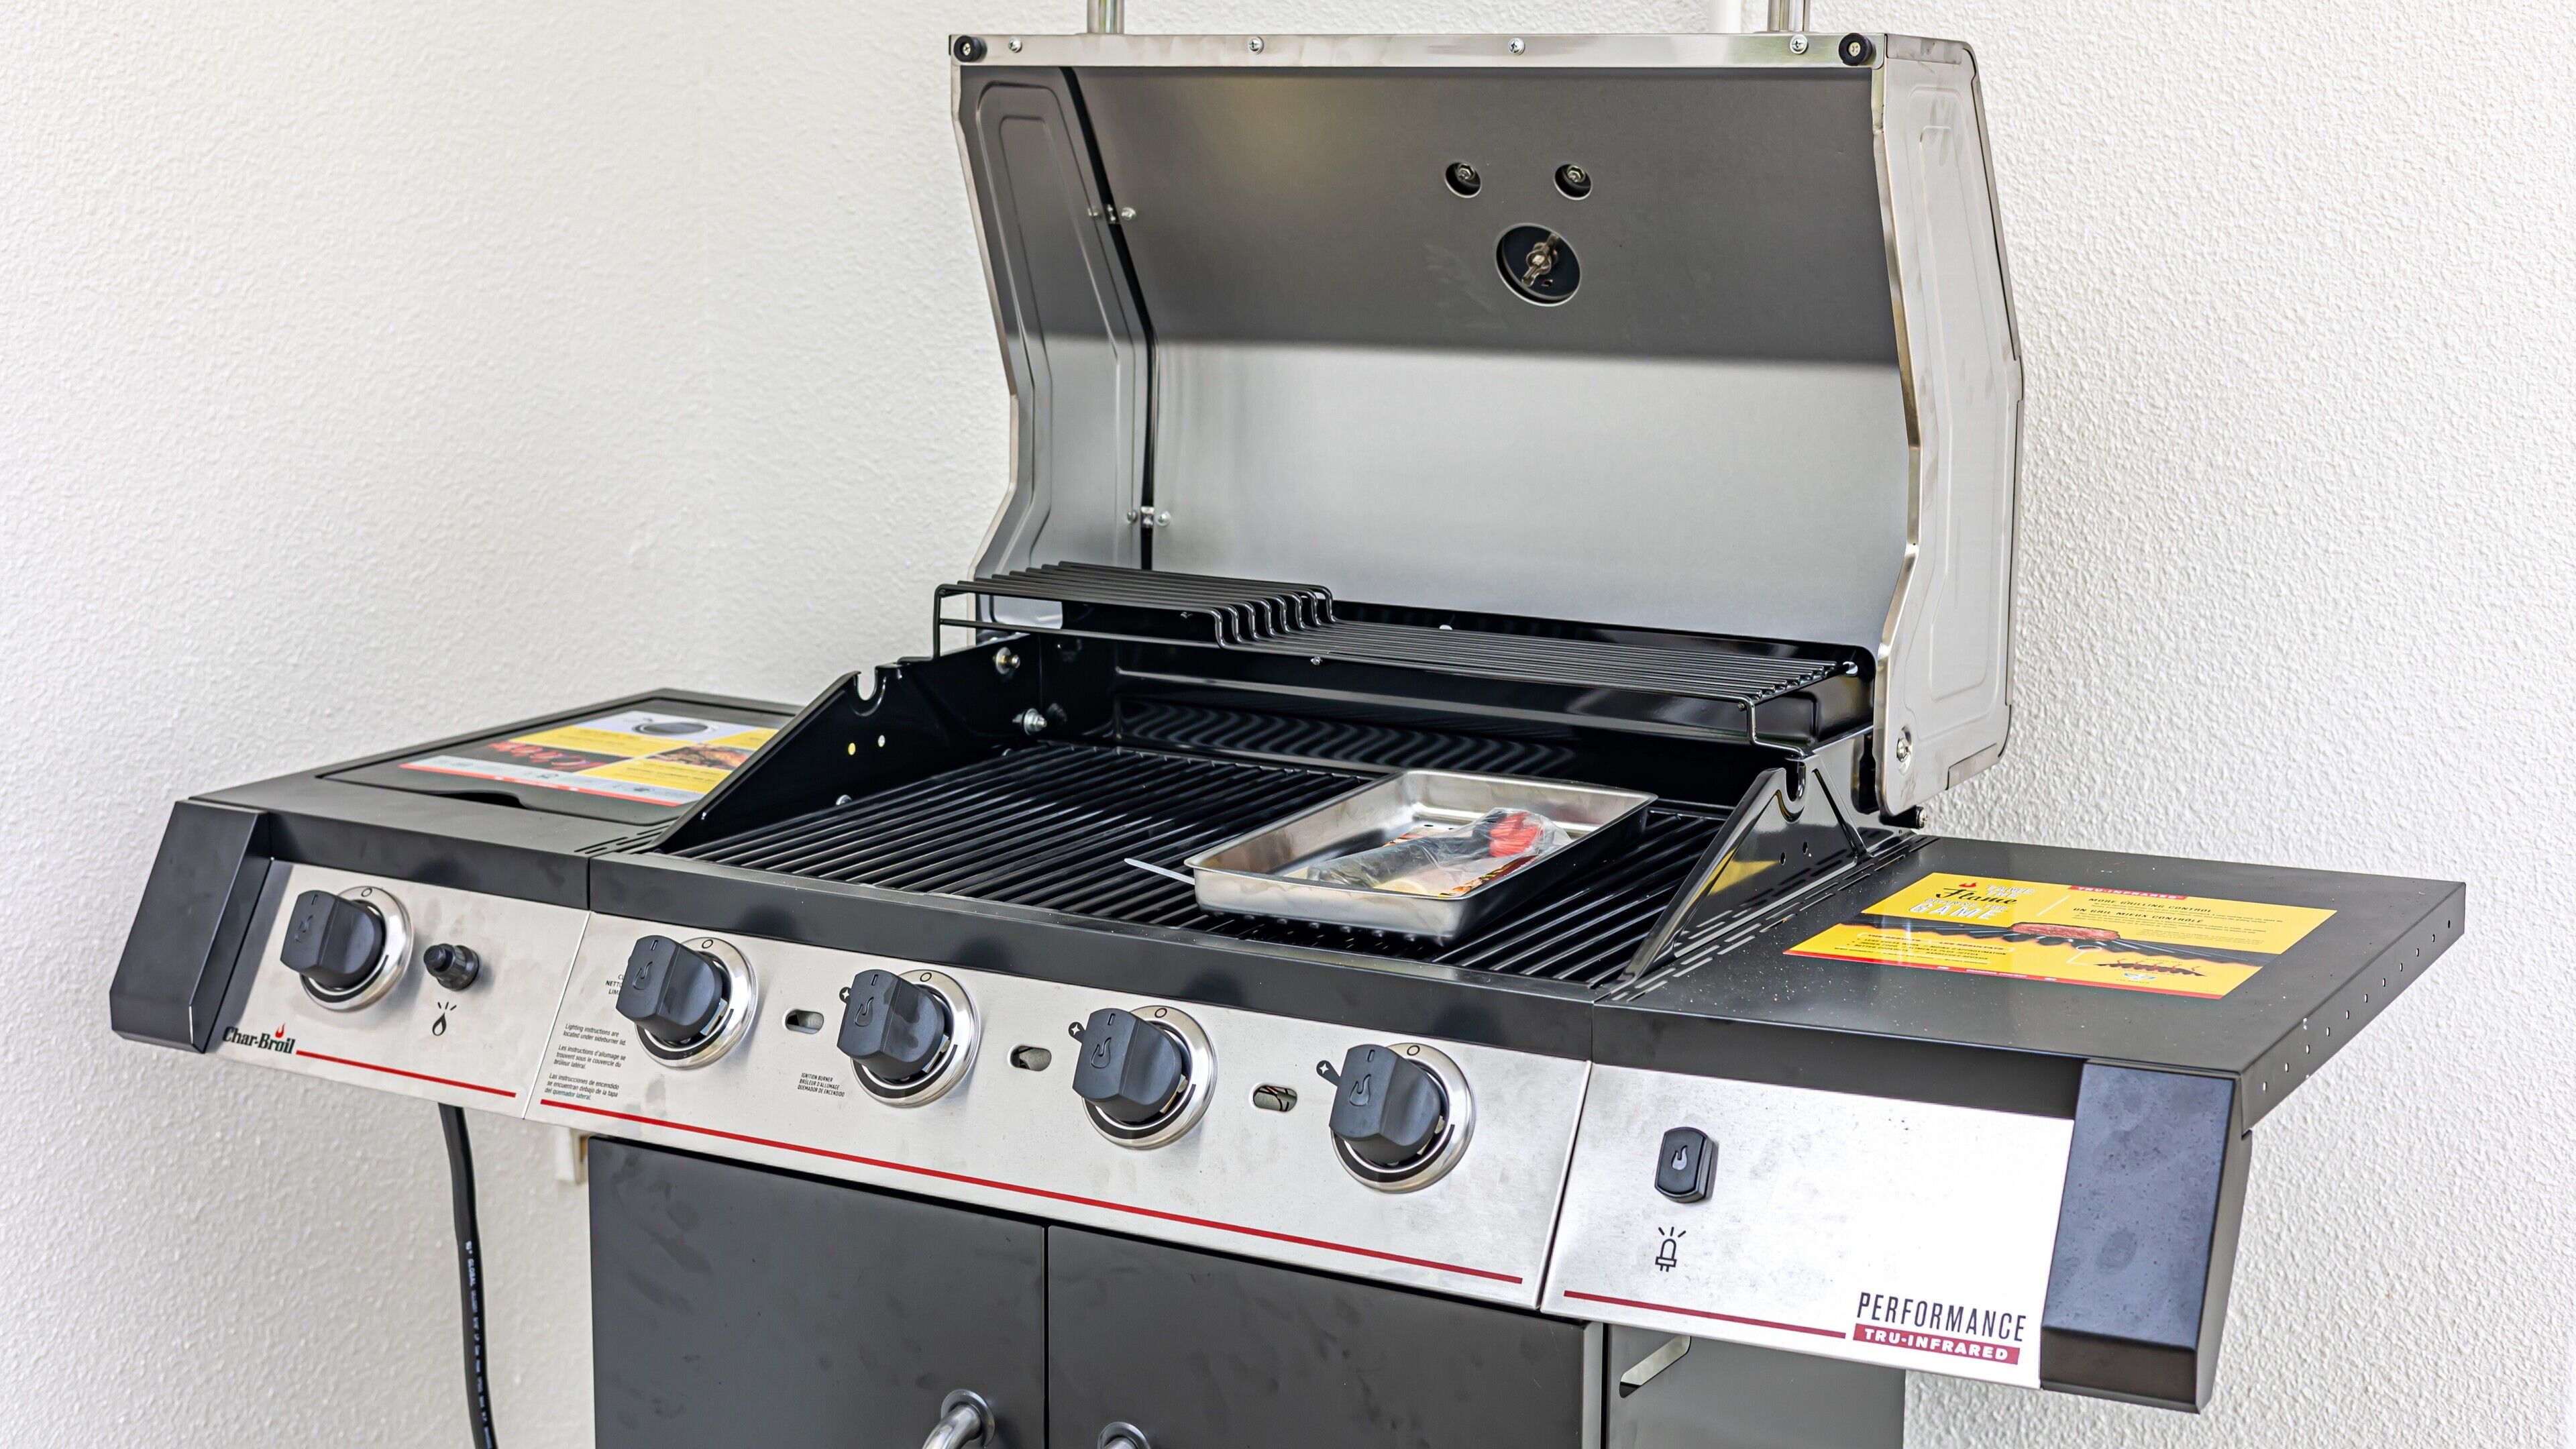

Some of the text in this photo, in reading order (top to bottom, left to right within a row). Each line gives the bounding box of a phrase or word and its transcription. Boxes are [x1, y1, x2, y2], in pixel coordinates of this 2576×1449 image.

[1936, 888, 2017, 904] Flame
[2078, 887, 2178, 899] TRU-INFRARED
[1909, 902, 2002, 919] GAME
[566, 1023, 584, 1032] Lighting
[584, 1026, 610, 1035] instructions
[223, 1026, 295, 1054] Char-Broil
[564, 1030, 580, 1038] located
[594, 1036, 619, 1044] sideburner
[556, 1052, 576, 1060] trouvent
[592, 1058, 614, 1066] couvercle
[568, 1046, 594, 1055] instructions
[594, 1051, 620, 1061] d'allumage
[553, 1081, 579, 1089] encuentran
[580, 1085, 595, 1093] debajo
[608, 1090, 618, 1098] tapa
[558, 1075, 588, 1084] instrucciones
[596, 1081, 619, 1090] encendido
[817, 1081, 840, 1090] D'ALLUMAGE
[552, 1089, 576, 1097] quemador
[824, 1089, 845, 1097] ENCENDIDO
[1857, 1292, 2026, 1342] PERFORMANCE
[1864, 1328, 2008, 1360] TRU-INFRARED
